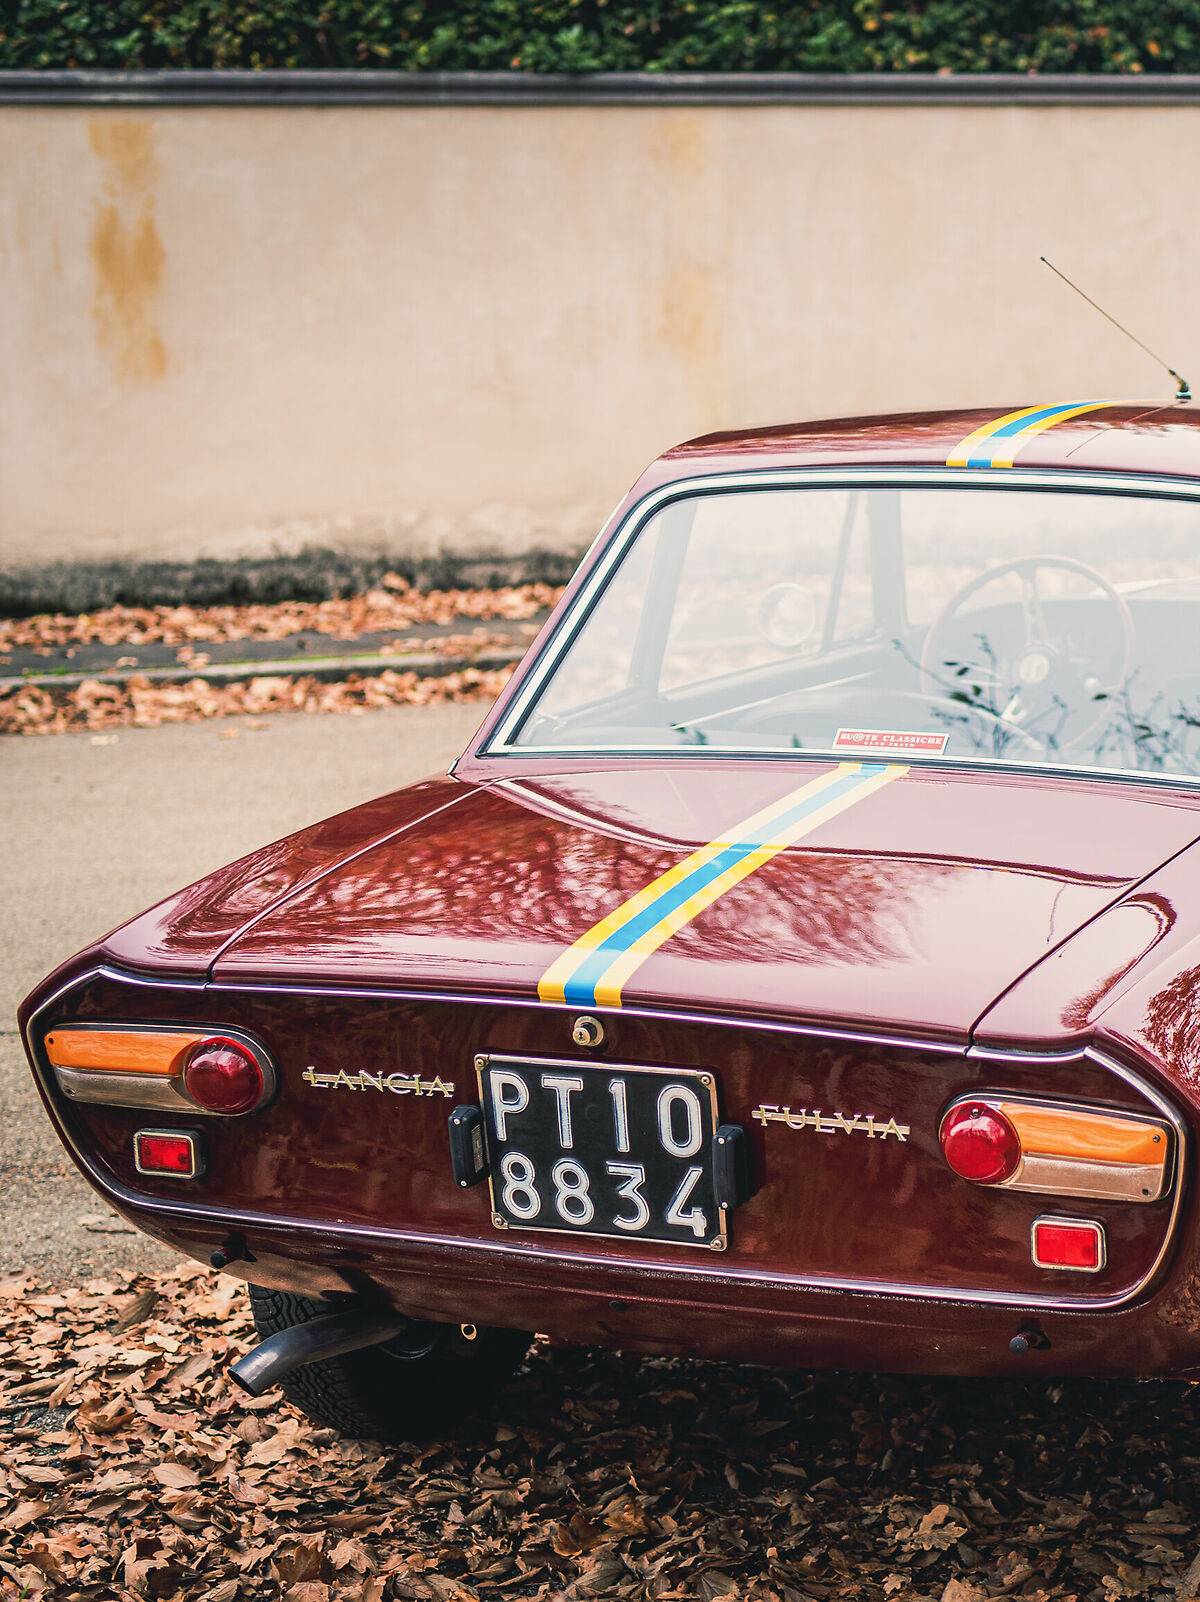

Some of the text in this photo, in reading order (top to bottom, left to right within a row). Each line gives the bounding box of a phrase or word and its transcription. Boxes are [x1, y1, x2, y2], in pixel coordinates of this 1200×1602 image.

[882, 735, 943, 745] CLASSICHE
[302, 1065, 455, 1098] LANCIA
[489, 1070, 703, 1158] PT10
[752, 1103, 910, 1142] FULVIA
[500, 1151, 708, 1238] 8834
